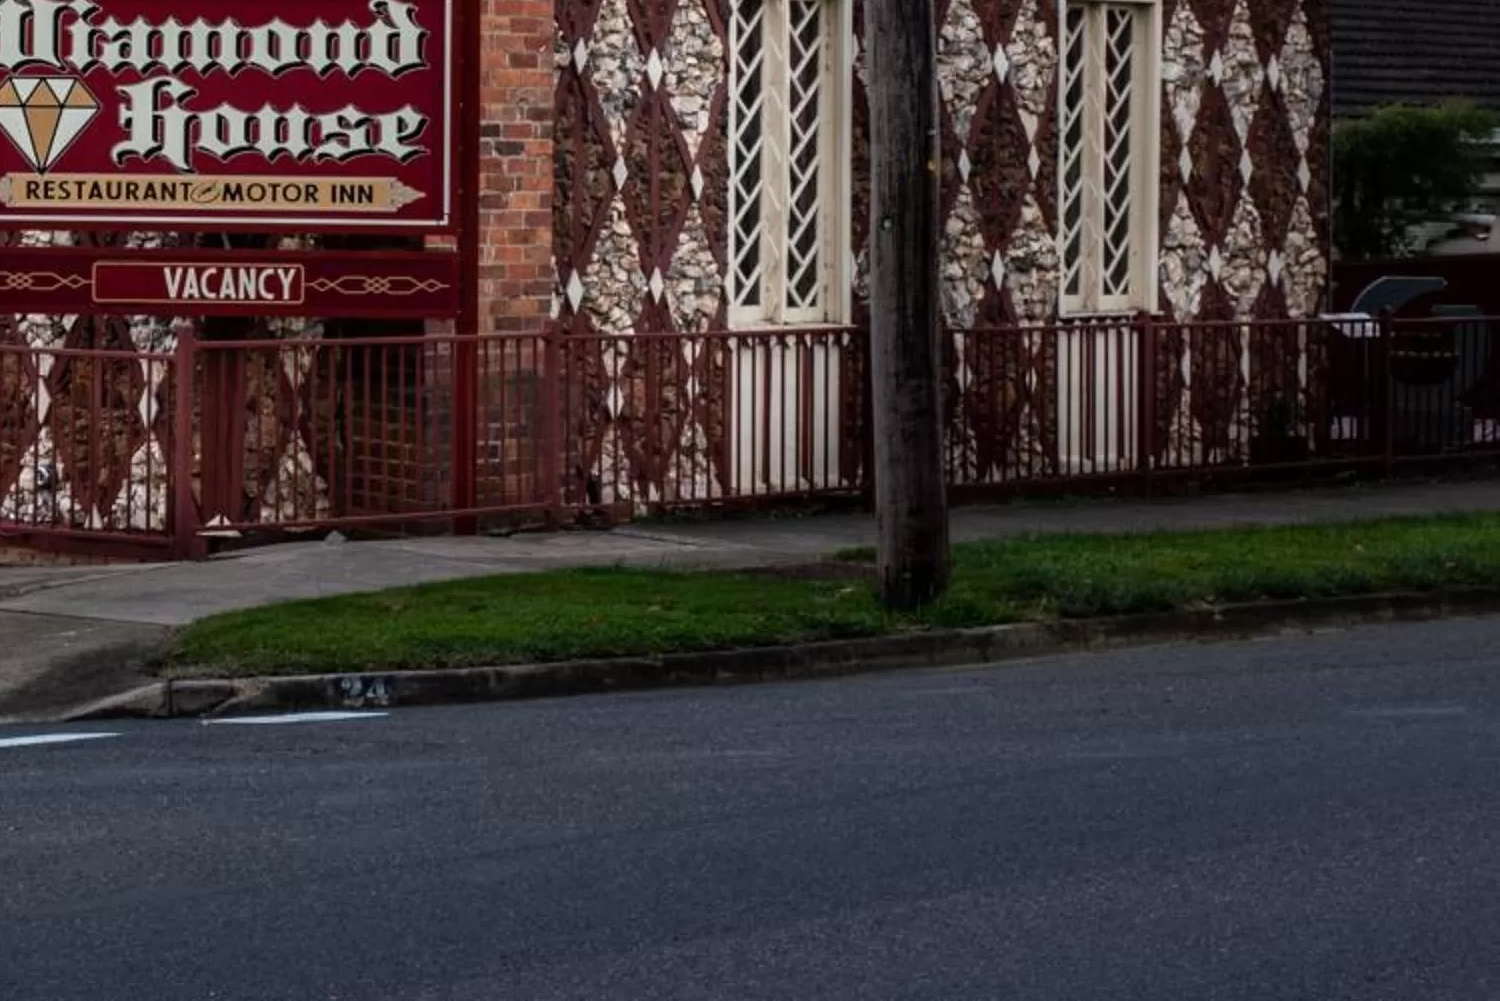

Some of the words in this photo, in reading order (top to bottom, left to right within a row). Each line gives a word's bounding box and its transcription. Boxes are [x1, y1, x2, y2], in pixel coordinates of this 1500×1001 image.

[108, 75, 431, 175] House
[25, 180, 193, 202] RESTAURANT
[222, 182, 319, 205] MOTOR
[330, 183, 375, 205] INN
[162, 265, 298, 301] VACANCY
